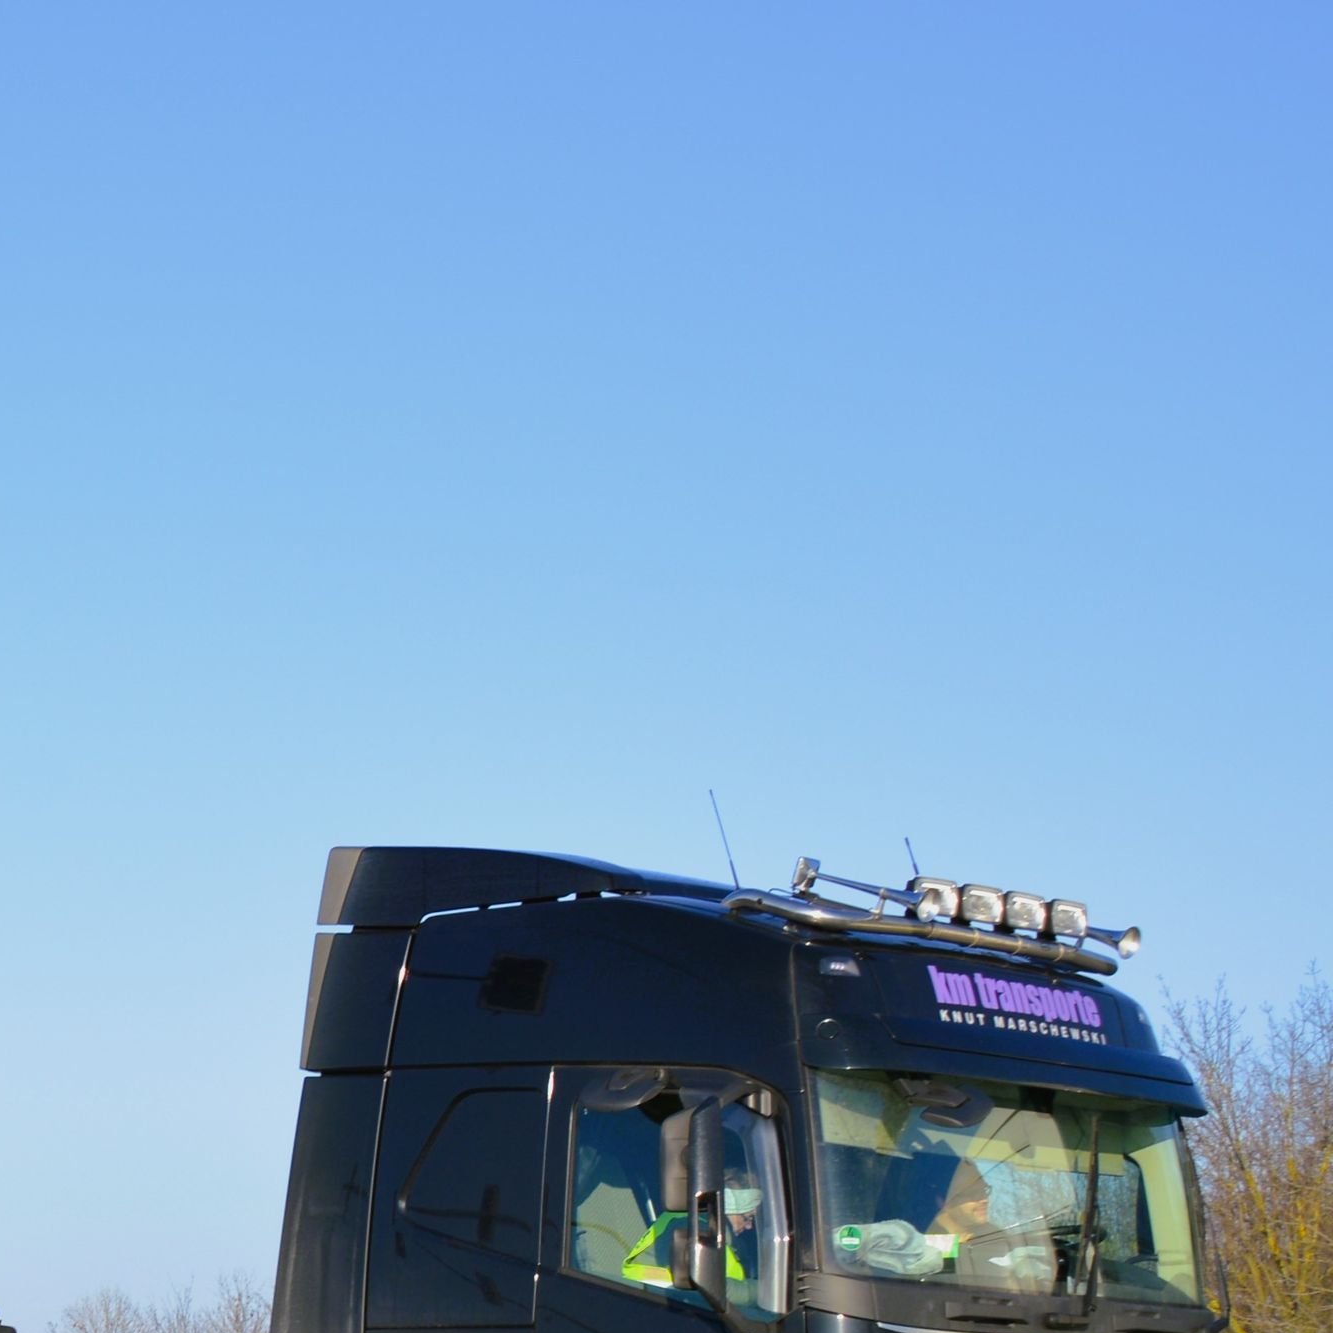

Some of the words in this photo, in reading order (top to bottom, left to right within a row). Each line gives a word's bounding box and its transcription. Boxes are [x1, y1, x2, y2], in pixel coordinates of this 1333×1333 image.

[927, 964, 977, 1007] km
[974, 972, 1102, 1028] transporte
[939, 1008, 986, 1026] KNUT
[993, 1015, 1108, 1046] MARSCHEWSKI
